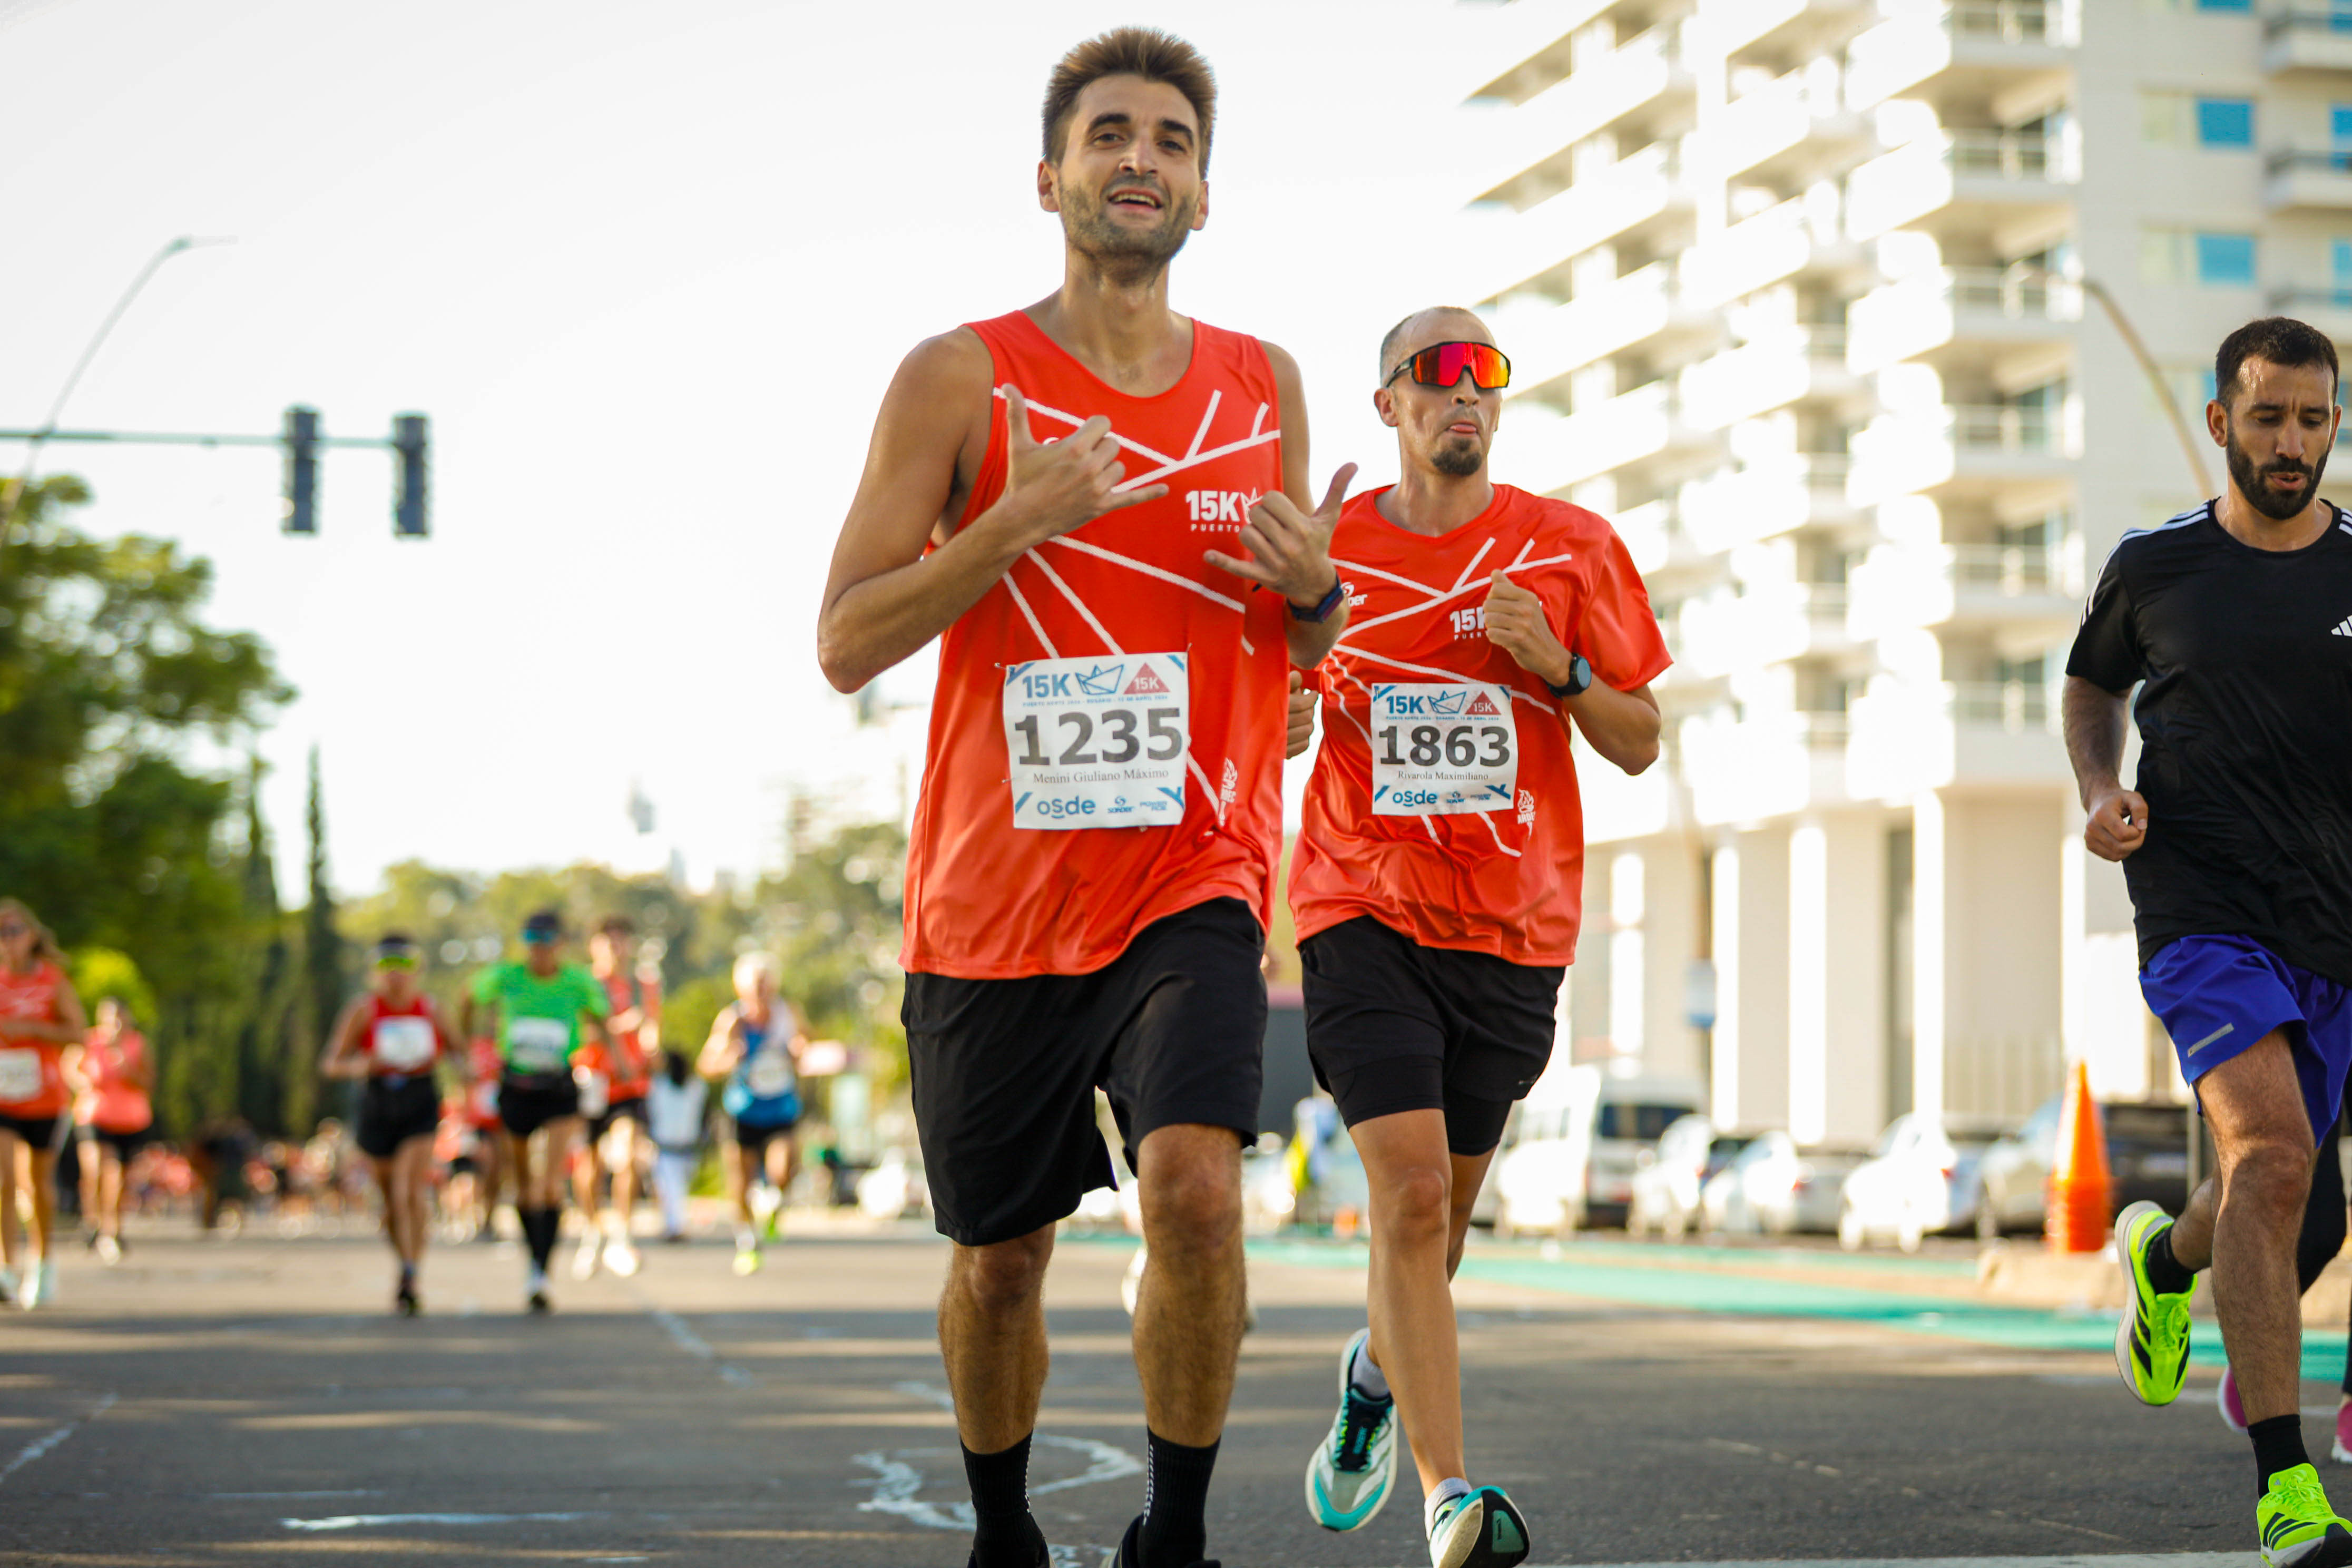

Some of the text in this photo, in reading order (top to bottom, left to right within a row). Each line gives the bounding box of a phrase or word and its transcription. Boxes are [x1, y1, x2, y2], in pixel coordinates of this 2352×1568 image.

[1185, 490, 1240, 522] 15K
[1191, 524, 1240, 533] PUERTO
[1454, 631, 1482, 641] PUER
[1023, 673, 1072, 699] 15K
[1133, 677, 1160, 690] 15K
[1386, 695, 1425, 714] 15K
[1474, 702, 1493, 712] 15K
[1015, 708, 1183, 766] 1235
[1379, 725, 1510, 767] 1863
[1033, 768, 1169, 784] Menini Giuliano Máximo
[1398, 771, 1489, 780] Rivarola Maximiliano
[1393, 789, 1438, 805] osde
[1037, 795, 1096, 816] osde
